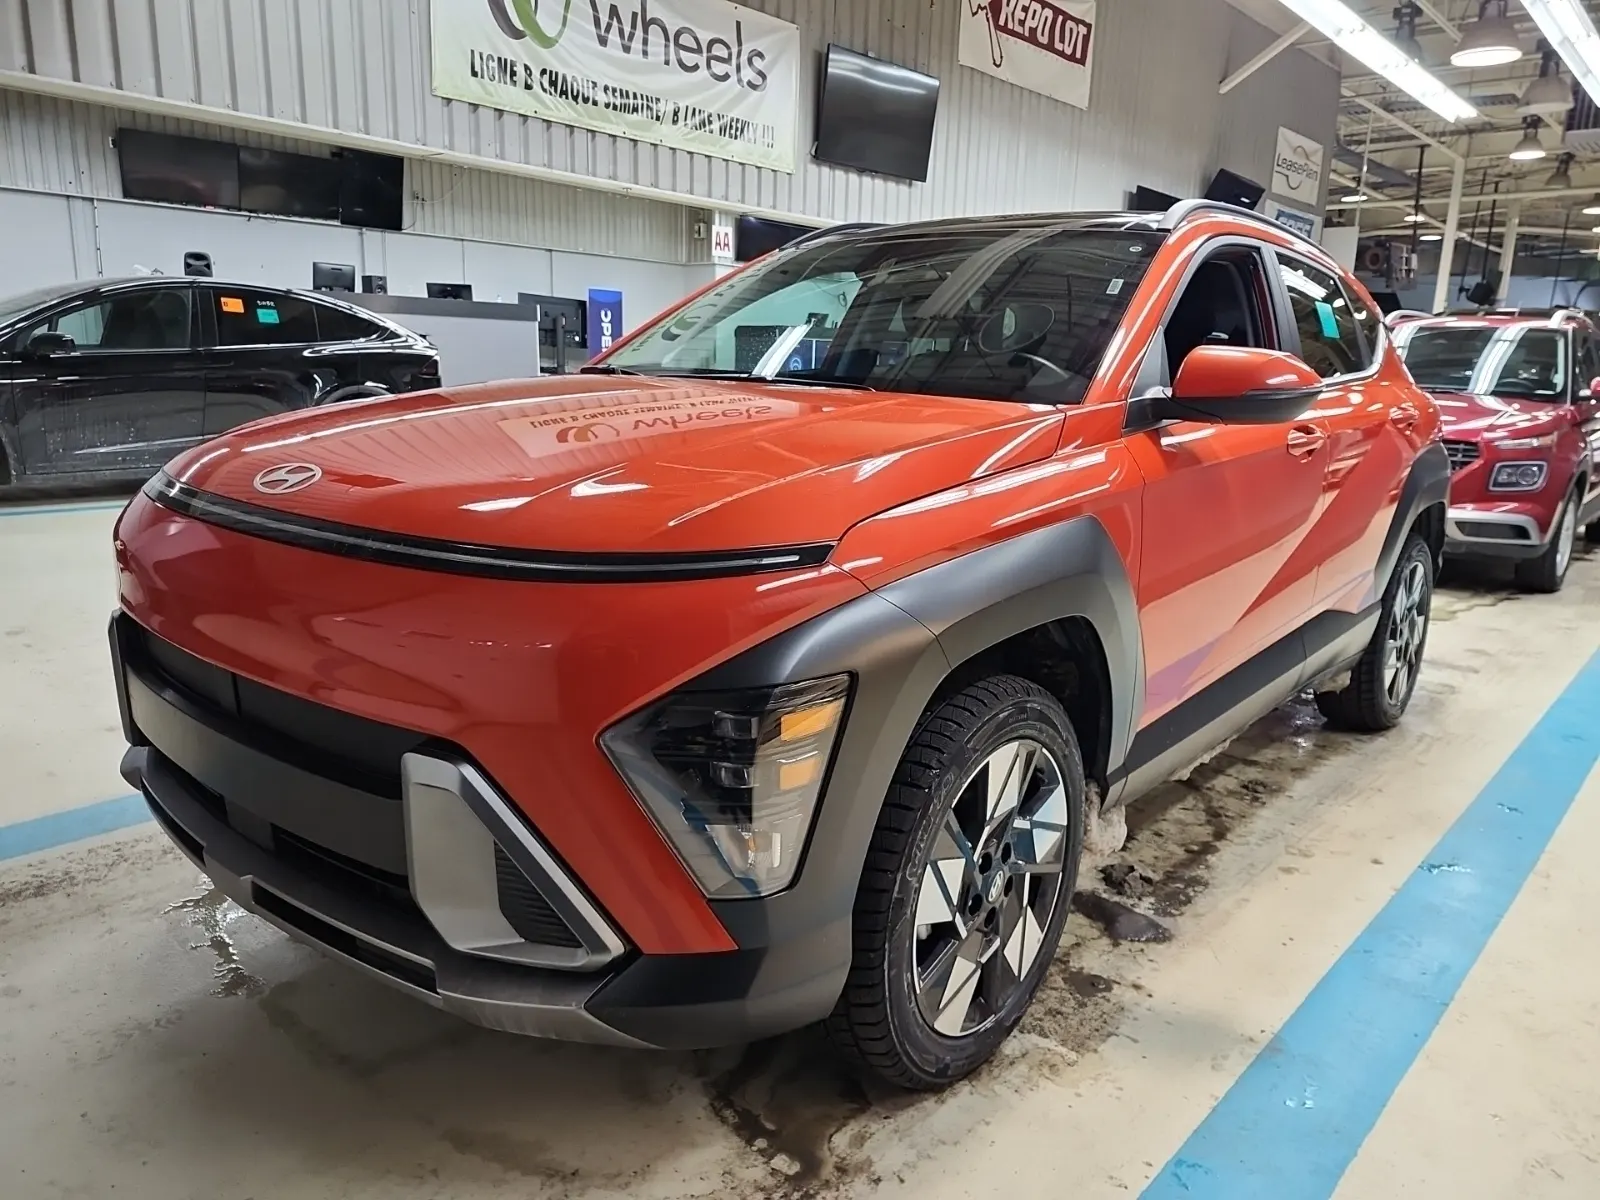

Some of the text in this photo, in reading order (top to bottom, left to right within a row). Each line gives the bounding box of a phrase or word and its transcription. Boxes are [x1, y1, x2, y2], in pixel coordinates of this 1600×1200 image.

[590, 0, 768, 92] wheels
[998, 0, 1088, 59] REPO LOT
[470, 49, 518, 88] LIGNE
[523, 63, 535, 91] B
[539, 68, 599, 106] CHAQUE
[671, 101, 681, 126] B
[684, 105, 714, 134] LANE
[717, 113, 759, 145] WEEKLY
[1276, 153, 1318, 182] LeasePlan
[715, 231, 731, 252] AA
